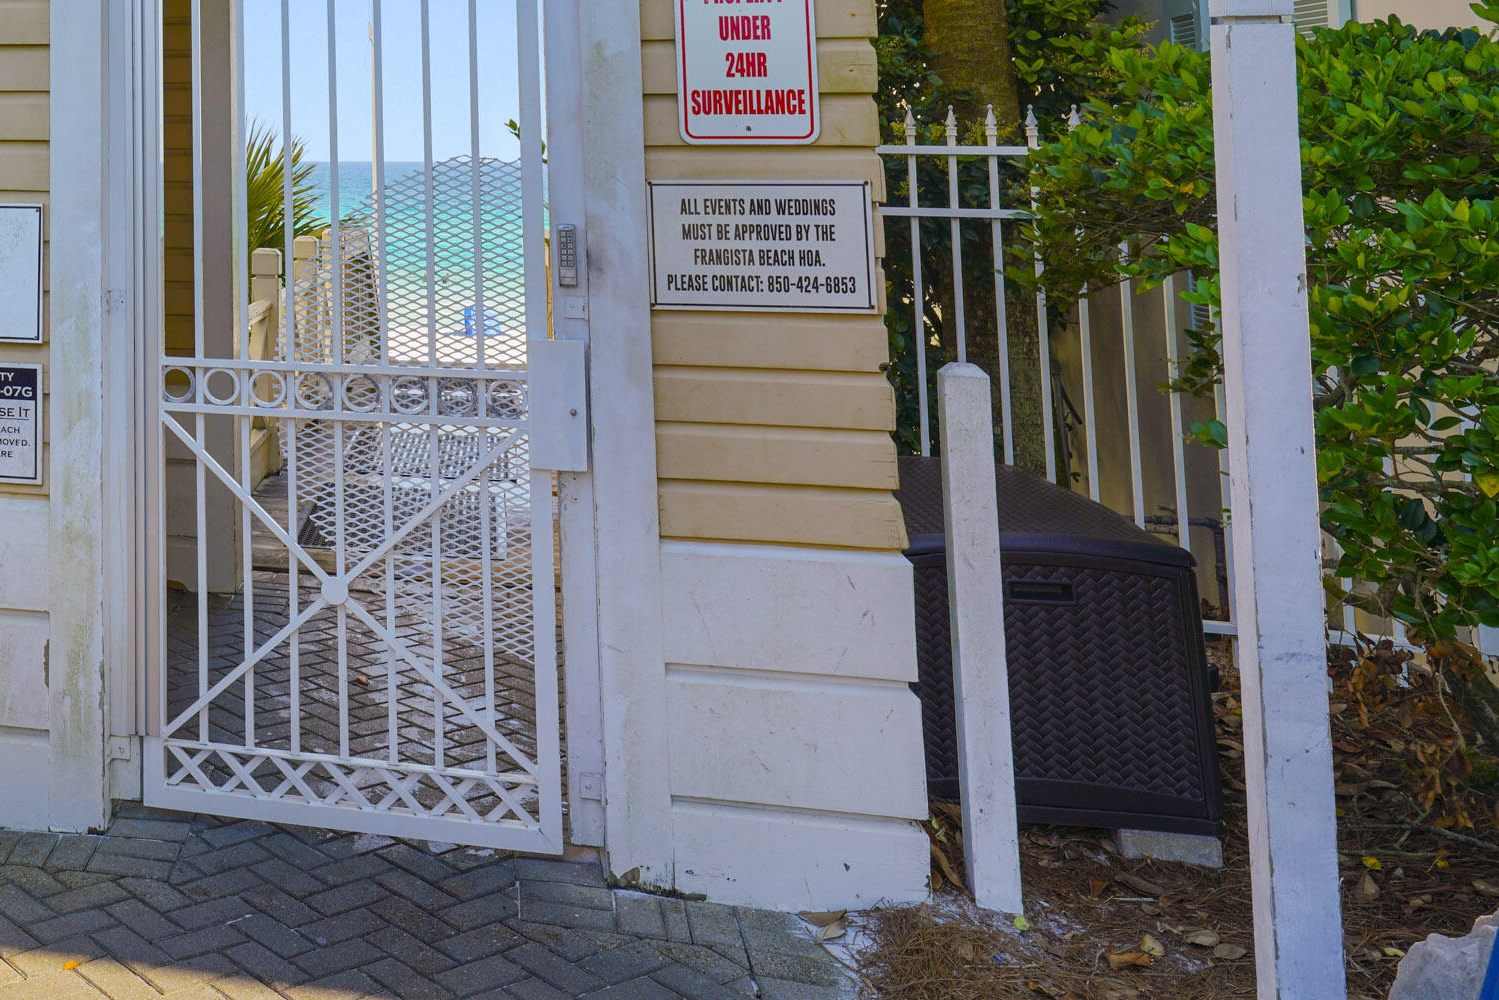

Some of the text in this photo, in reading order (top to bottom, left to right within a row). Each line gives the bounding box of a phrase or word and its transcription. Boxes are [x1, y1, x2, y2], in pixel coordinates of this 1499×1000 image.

[719, 15, 771, 41] UNDER
[725, 52, 768, 78] 24HR
[691, 89, 806, 116] SURVEILLANCE
[680, 198, 836, 216] ALL EVENTS AND WEDDINGS
[682, 224, 836, 241] MUST BE APPROVED BY THE
[694, 248, 826, 267] FRANGISTA BEACH HOA.
[667, 274, 856, 293] PLEASE CONTACT: 850-424-6853
[19, 406, 30, 417] IT
